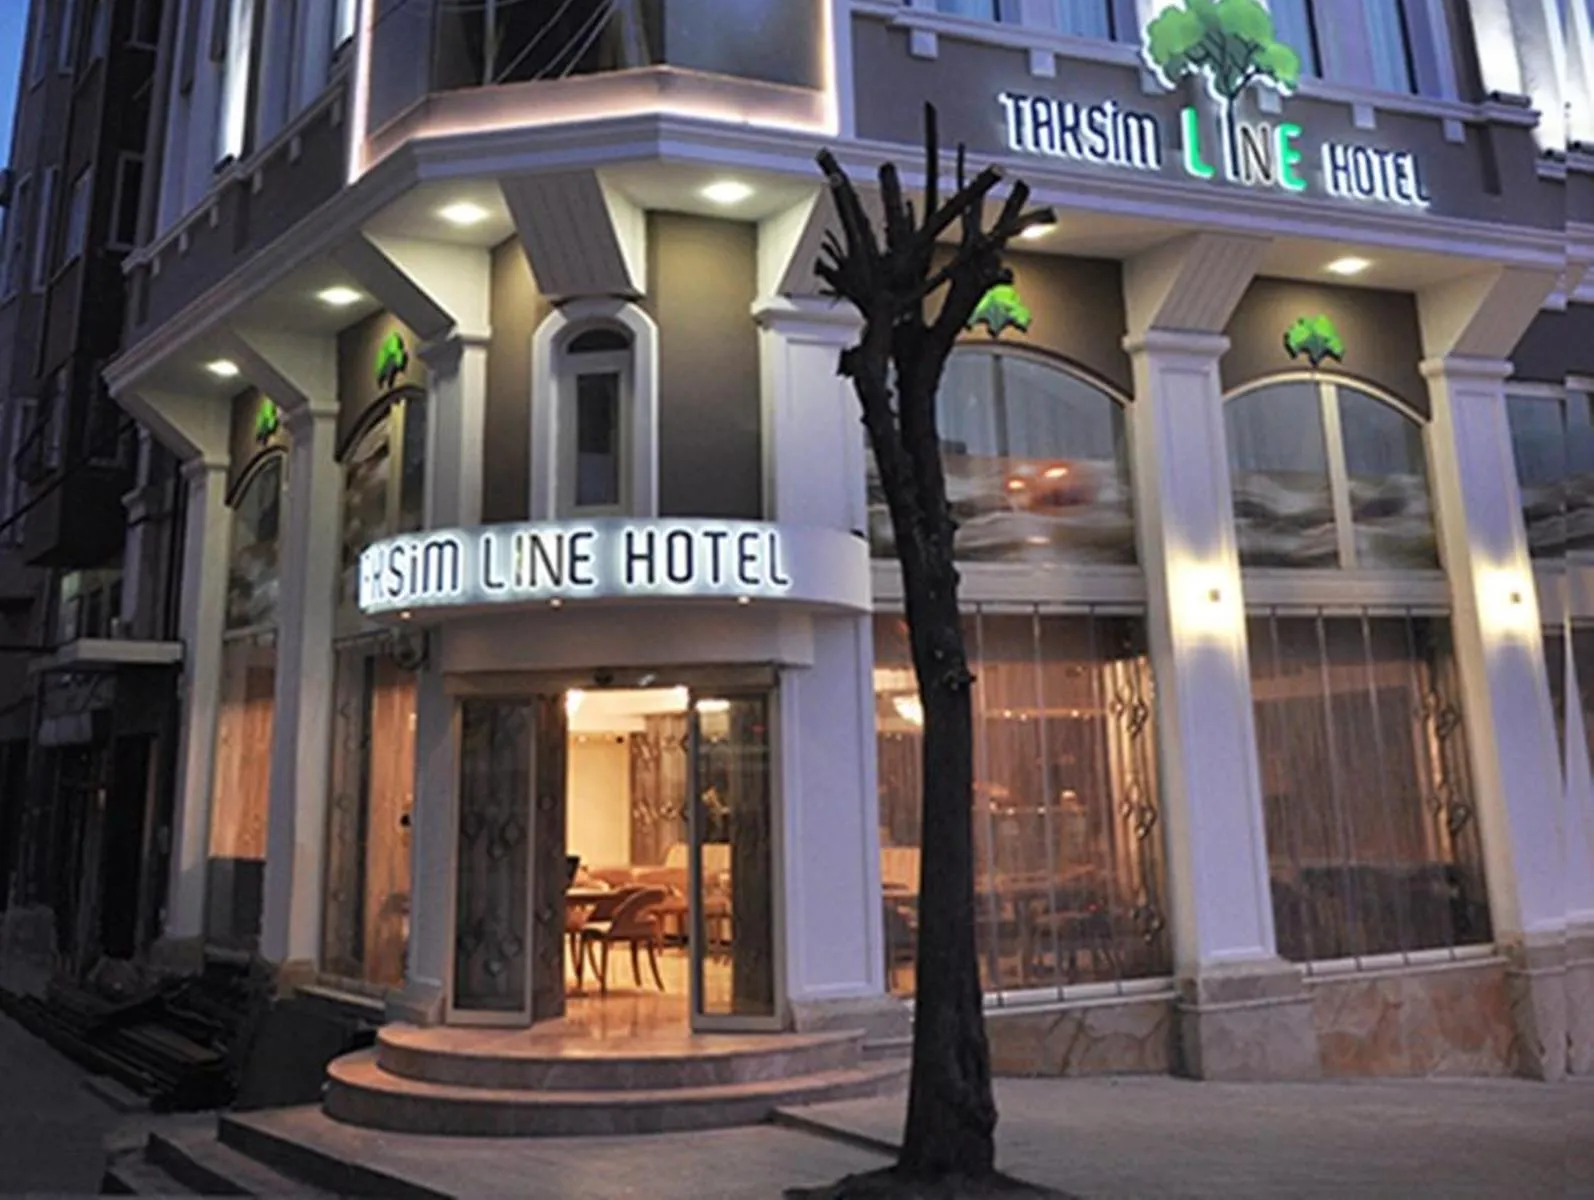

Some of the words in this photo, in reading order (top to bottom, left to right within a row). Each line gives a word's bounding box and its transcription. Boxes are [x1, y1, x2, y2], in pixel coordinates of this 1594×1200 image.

[1181, 102, 1308, 192] LINE
[1322, 143, 1431, 208] HOTEL
[481, 531, 596, 588] LINE
[626, 530, 789, 586] HOTEL
